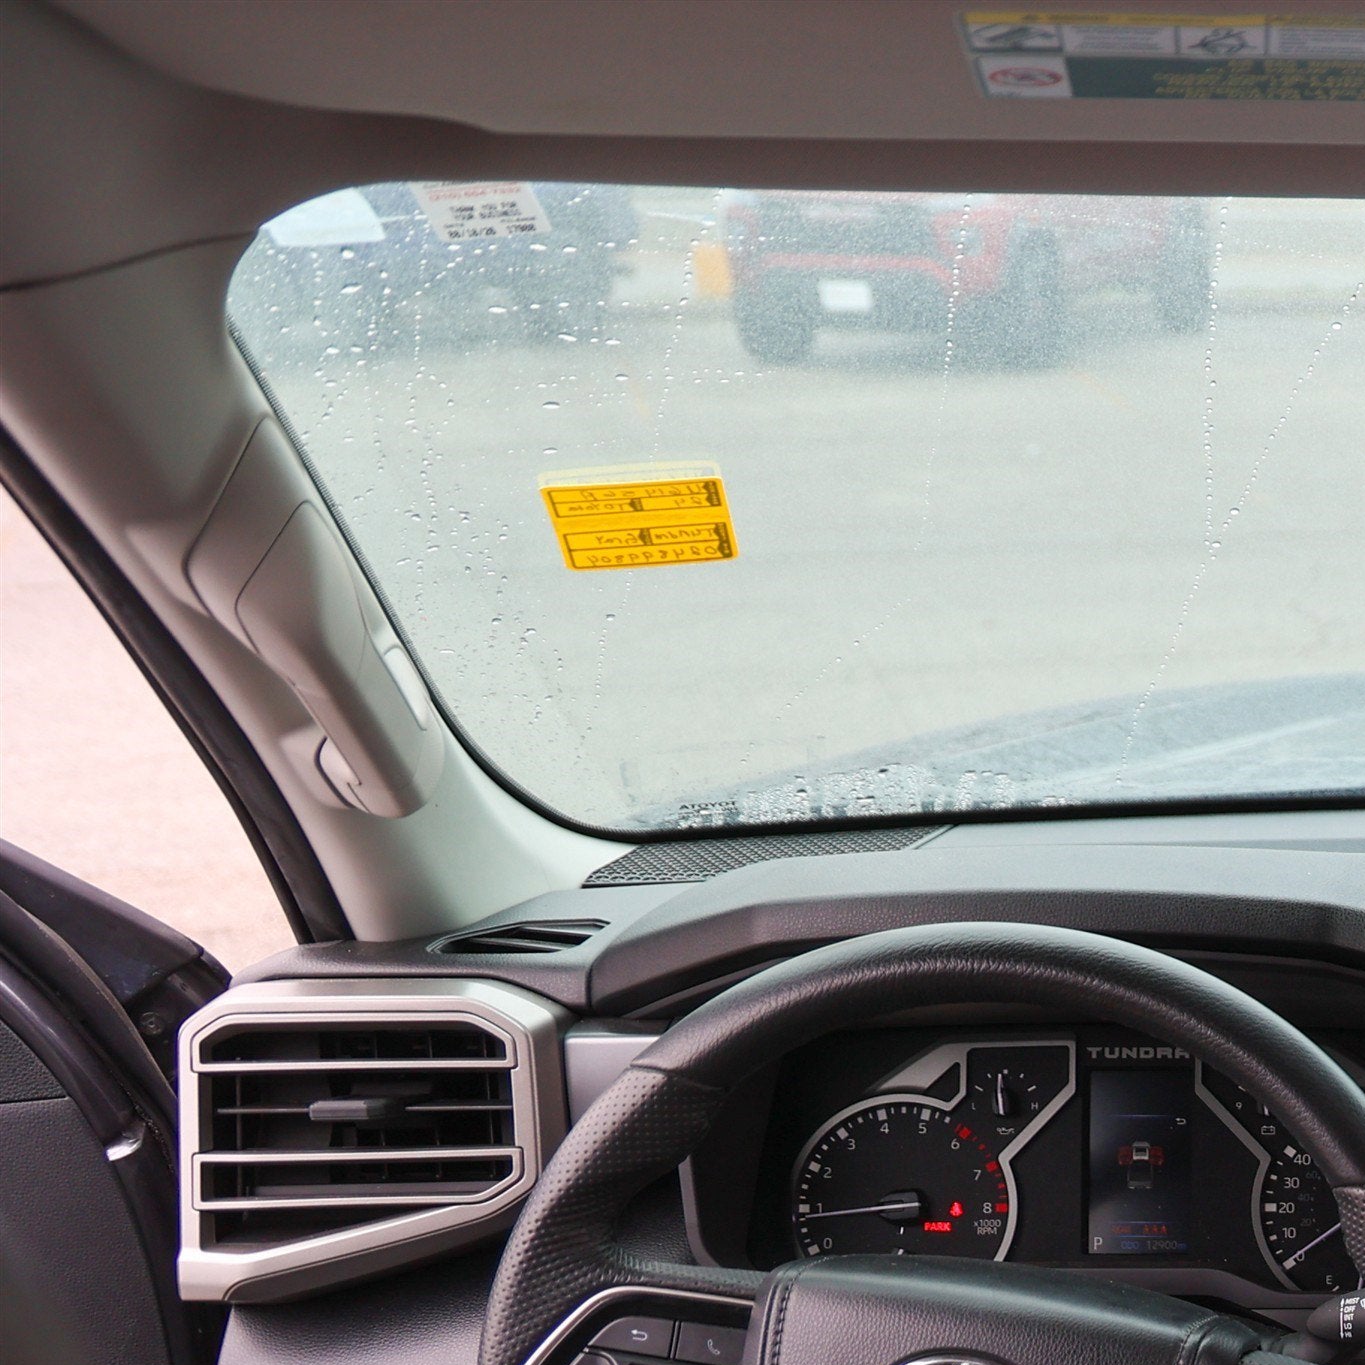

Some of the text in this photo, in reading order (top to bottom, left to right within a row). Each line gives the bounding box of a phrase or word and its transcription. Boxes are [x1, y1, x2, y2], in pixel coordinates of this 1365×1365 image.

[1086, 1047, 1190, 1059] TUNDRA
[1030, 1101, 1038, 1110] H
[879, 1122, 890, 1134] 4
[918, 1122, 928, 1134] 5
[847, 1138, 856, 1150] 3
[951, 1138, 960, 1150] 6
[1293, 1153, 1311, 1166] 40
[823, 1166, 832, 1179] 2
[973, 1169, 982, 1181] 7
[1284, 1177, 1300, 1189] 30
[817, 1202, 824, 1214] 1
[982, 1202, 993, 1214] 8
[1278, 1202, 1295, 1214] 20
[924, 1221, 951, 1232] PARK
[973, 1219, 1002, 1228] x1000
[976, 1227, 998, 1236] RPM
[1282, 1227, 1297, 1239] 10
[823, 1237, 833, 1249] 0
[1093, 1236, 1103, 1250] P
[1325, 1275, 1332, 1285] E
[1344, 1297, 1360, 1305] MIST
[1343, 1305, 1356, 1313] OFF
[1343, 1313, 1355, 1321] INT
[1343, 1322, 1353, 1330] LO
